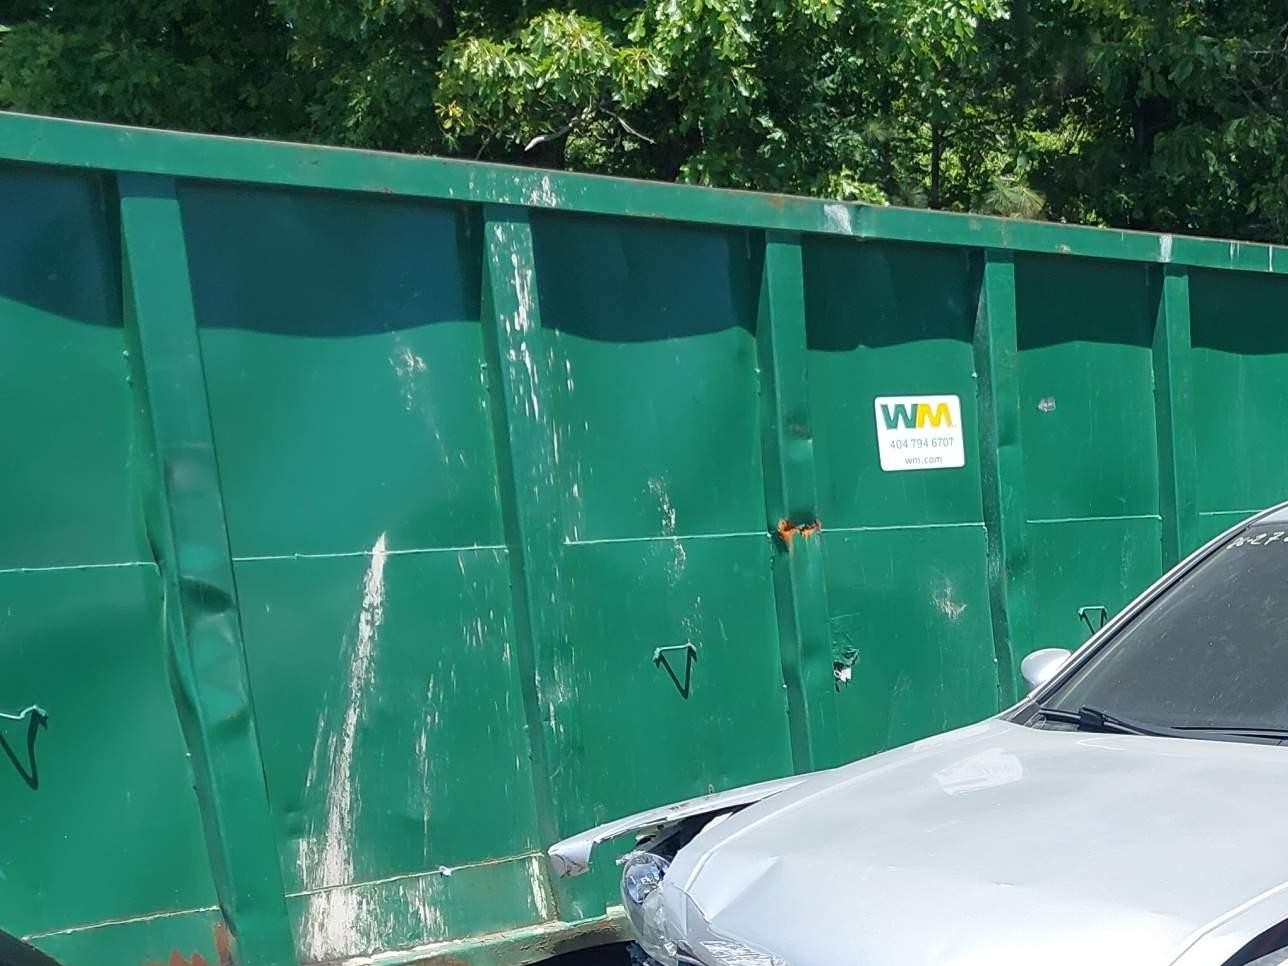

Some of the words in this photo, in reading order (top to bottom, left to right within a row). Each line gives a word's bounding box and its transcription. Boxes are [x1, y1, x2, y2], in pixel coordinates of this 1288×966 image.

[880, 403, 953, 429] WM
[890, 440, 908, 449] 404
[911, 438, 929, 449] 794
[931, 437, 954, 448] 6707
[905, 456, 943, 465] wm.com
